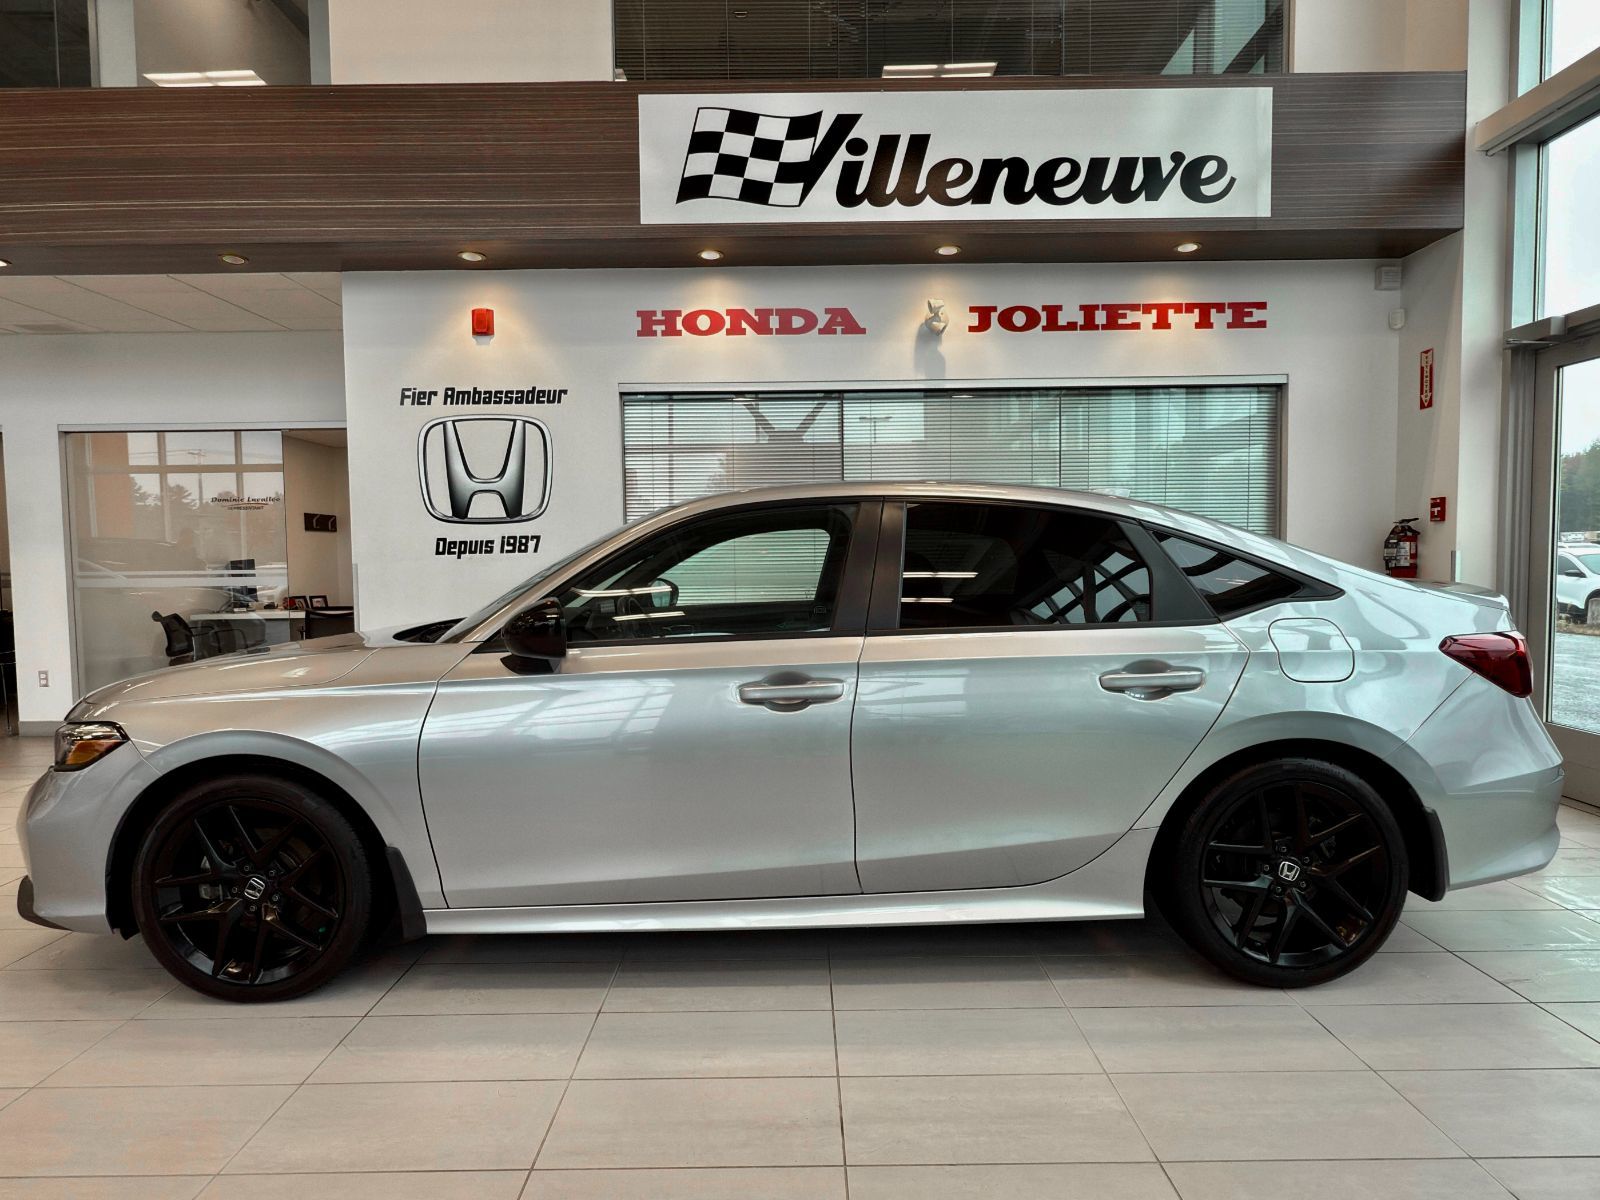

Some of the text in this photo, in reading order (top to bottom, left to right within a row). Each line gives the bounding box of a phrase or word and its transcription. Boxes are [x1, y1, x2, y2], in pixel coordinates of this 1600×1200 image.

[676, 107, 1236, 209] Villeneuve
[637, 302, 1267, 337] HONDA JOLIETTE
[400, 386, 568, 406] Fier Ambassadeur
[435, 535, 541, 559] Depuis 1987
